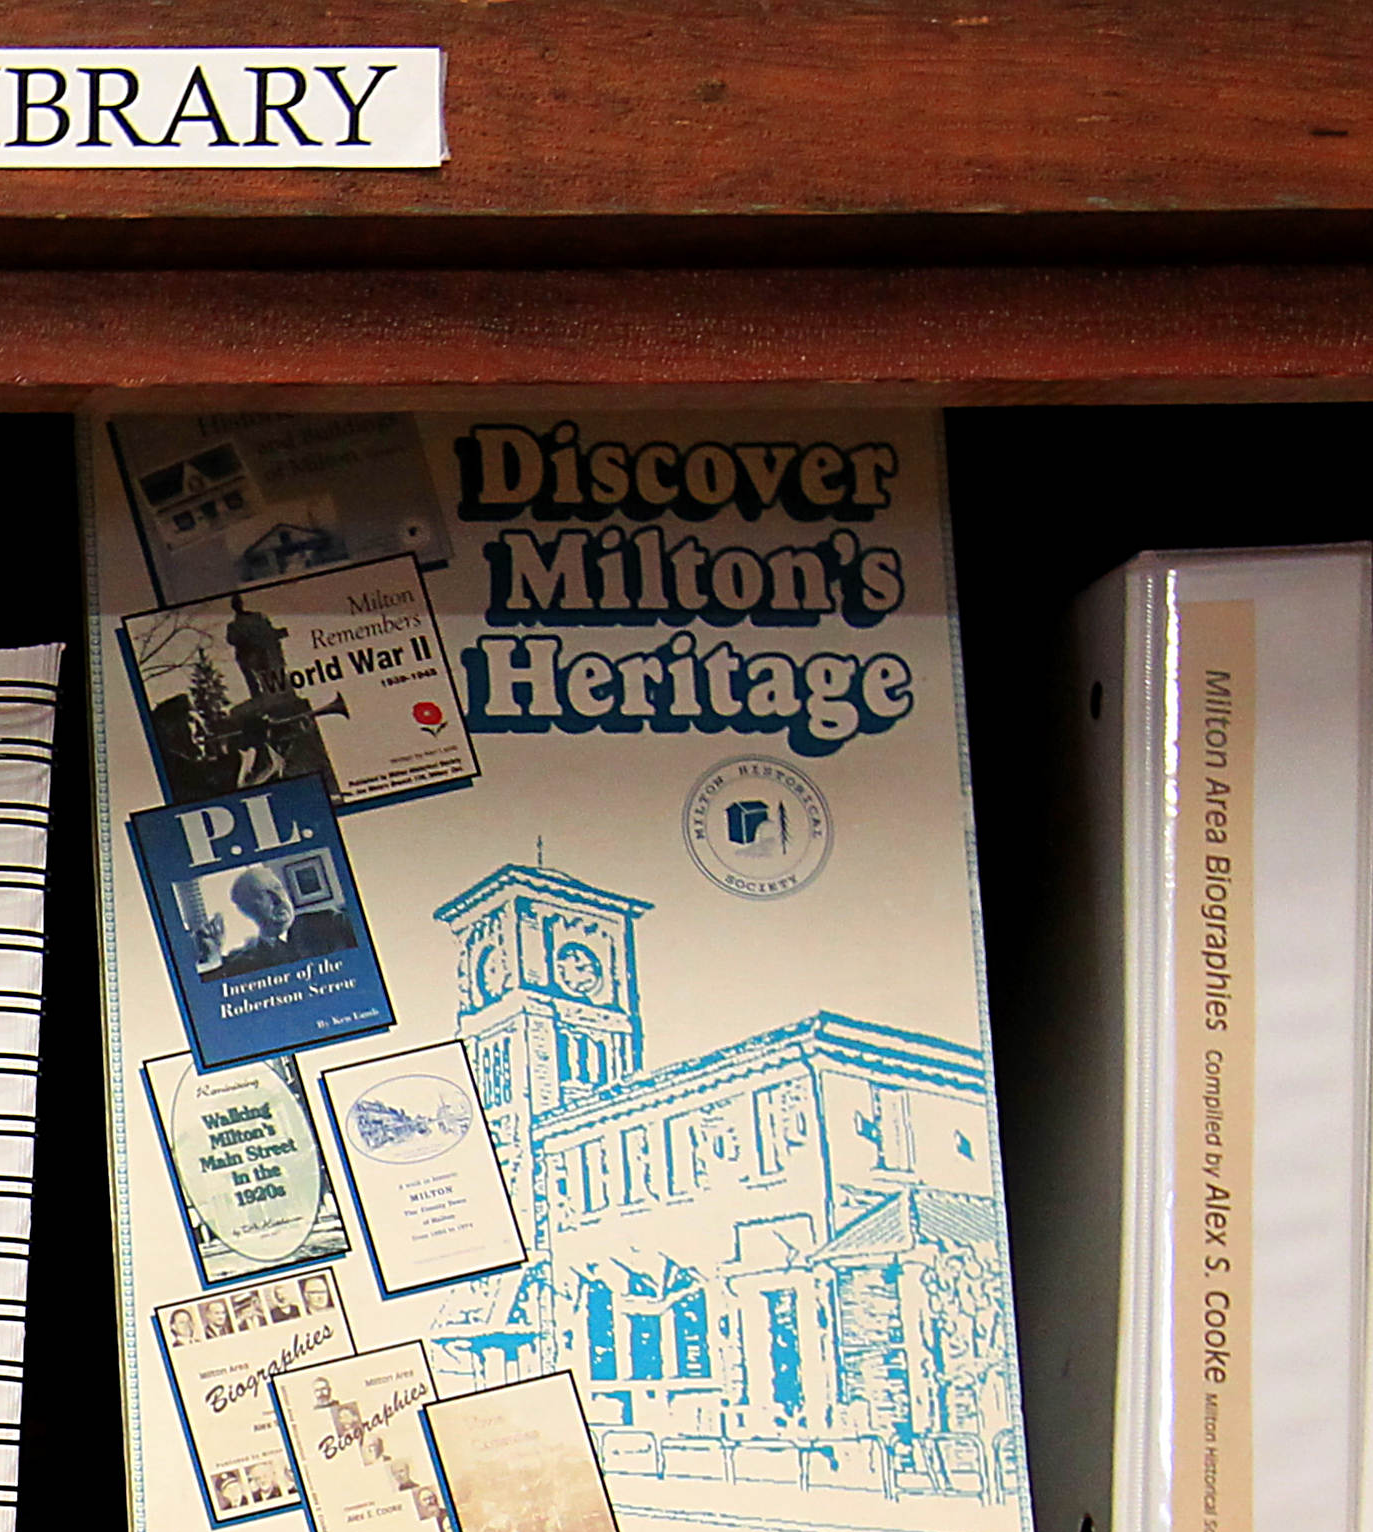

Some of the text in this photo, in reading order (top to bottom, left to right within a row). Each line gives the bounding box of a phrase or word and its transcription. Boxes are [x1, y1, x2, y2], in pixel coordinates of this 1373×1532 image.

[457, 421, 898, 521] Discover
[483, 529, 906, 625] Milton's
[348, 588, 414, 616] Milton
[311, 614, 421, 648] Remembers
[260, 636, 432, 694] World War II
[463, 632, 914, 755] Heritage
[175, 793, 313, 867] P.L.
[725, 875, 797, 892] SOCIETY
[222, 959, 343, 997] Inventor of the
[220, 979, 356, 1019] Robertson Screw
[1201, 669, 1232, 1383] Milton Area Biographies Compiled by Alex S. Cooke
[201, 1103, 270, 1130] Walking
[199, 1138, 297, 1173] Main Street
[210, 1123, 276, 1150] Milton's
[232, 1164, 282, 1186] in the
[235, 1184, 286, 1207] 1920s
[319, 1385, 427, 1460] Biographies
